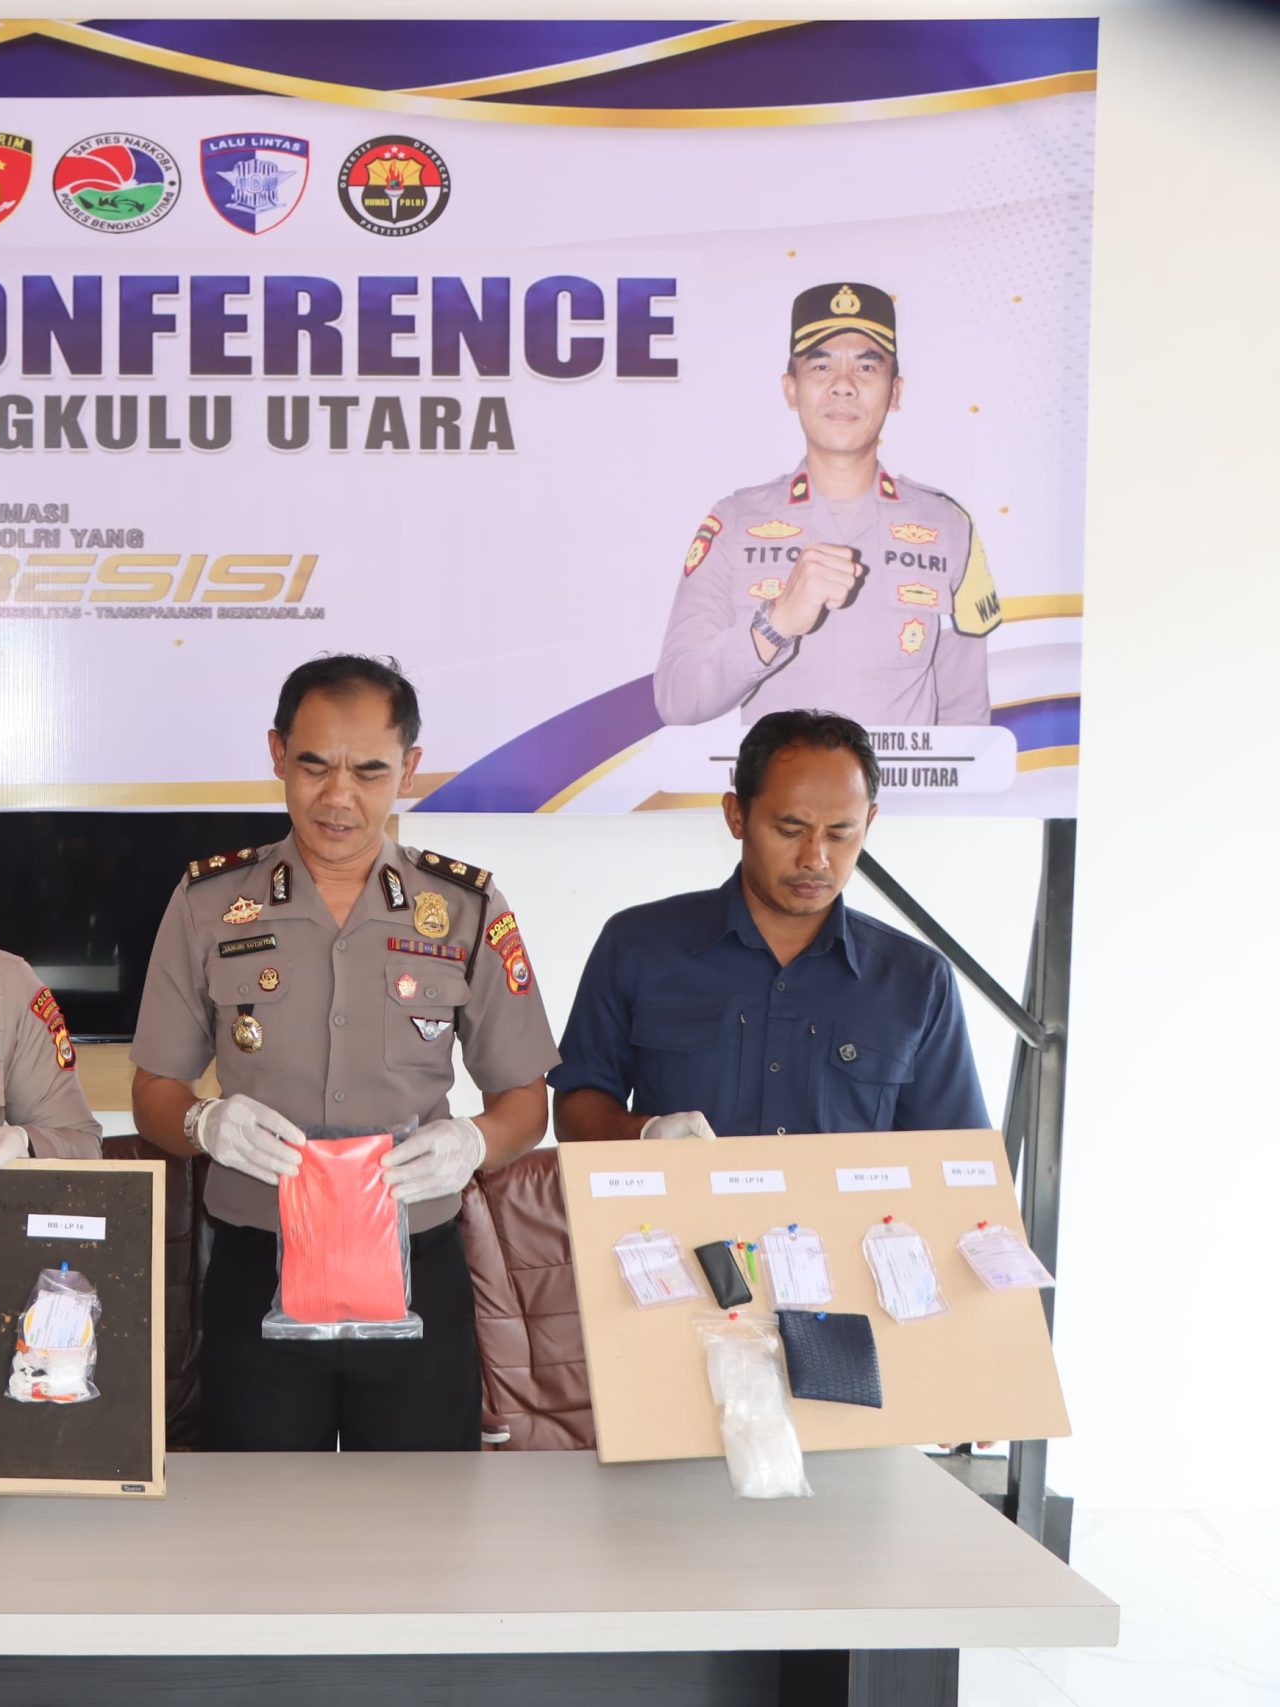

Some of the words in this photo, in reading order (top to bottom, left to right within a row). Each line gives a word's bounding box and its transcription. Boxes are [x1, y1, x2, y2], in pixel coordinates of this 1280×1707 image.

[73, 141, 93, 156] SAT
[96, 136, 120, 145] RES
[124, 137, 173, 172] NARKOBA
[209, 138, 245, 151] LALU
[251, 137, 301, 152] LINTAS
[413, 141, 449, 193] DIPERCAYA
[61, 193, 91, 223] POLRES
[360, 219, 429, 236] PARTISIPASI
[267, 395, 516, 451] UTARA
[70, 529, 144, 549] YANG
[744, 546, 802, 564] TITO
[885, 550, 948, 573] POLRI
[867, 732, 908, 751] TIRTO.
[911, 731, 933, 750] S.H.
[912, 767, 959, 787] UTARA
